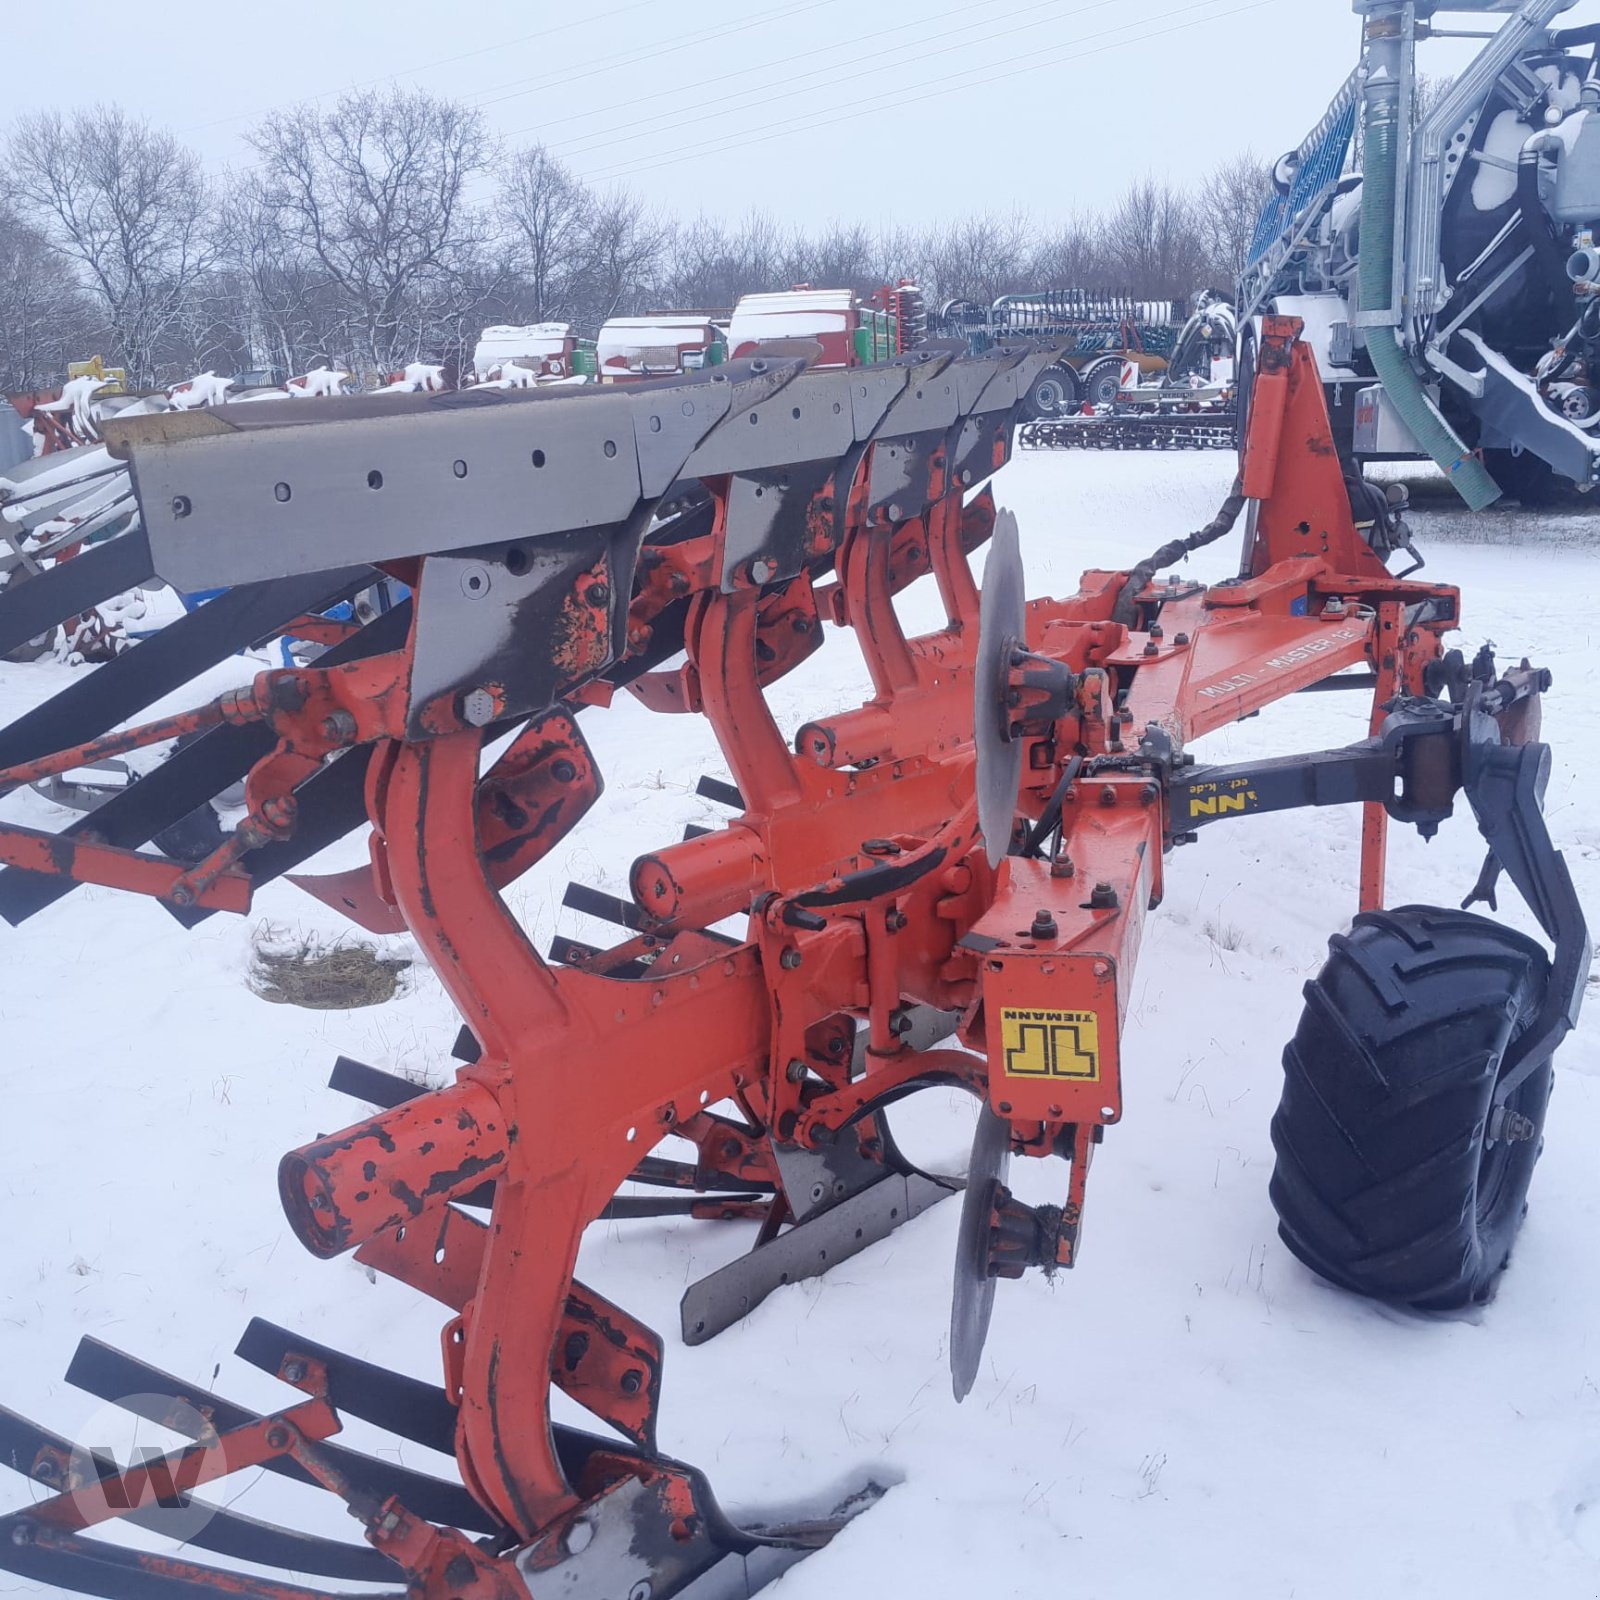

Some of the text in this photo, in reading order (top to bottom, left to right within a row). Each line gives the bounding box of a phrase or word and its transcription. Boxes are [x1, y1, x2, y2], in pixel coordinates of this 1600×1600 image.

[1199, 673, 1257, 698] MULTI
[1266, 638, 1336, 668] MASTER
[1004, 1010, 1094, 1023] TIEMANN
